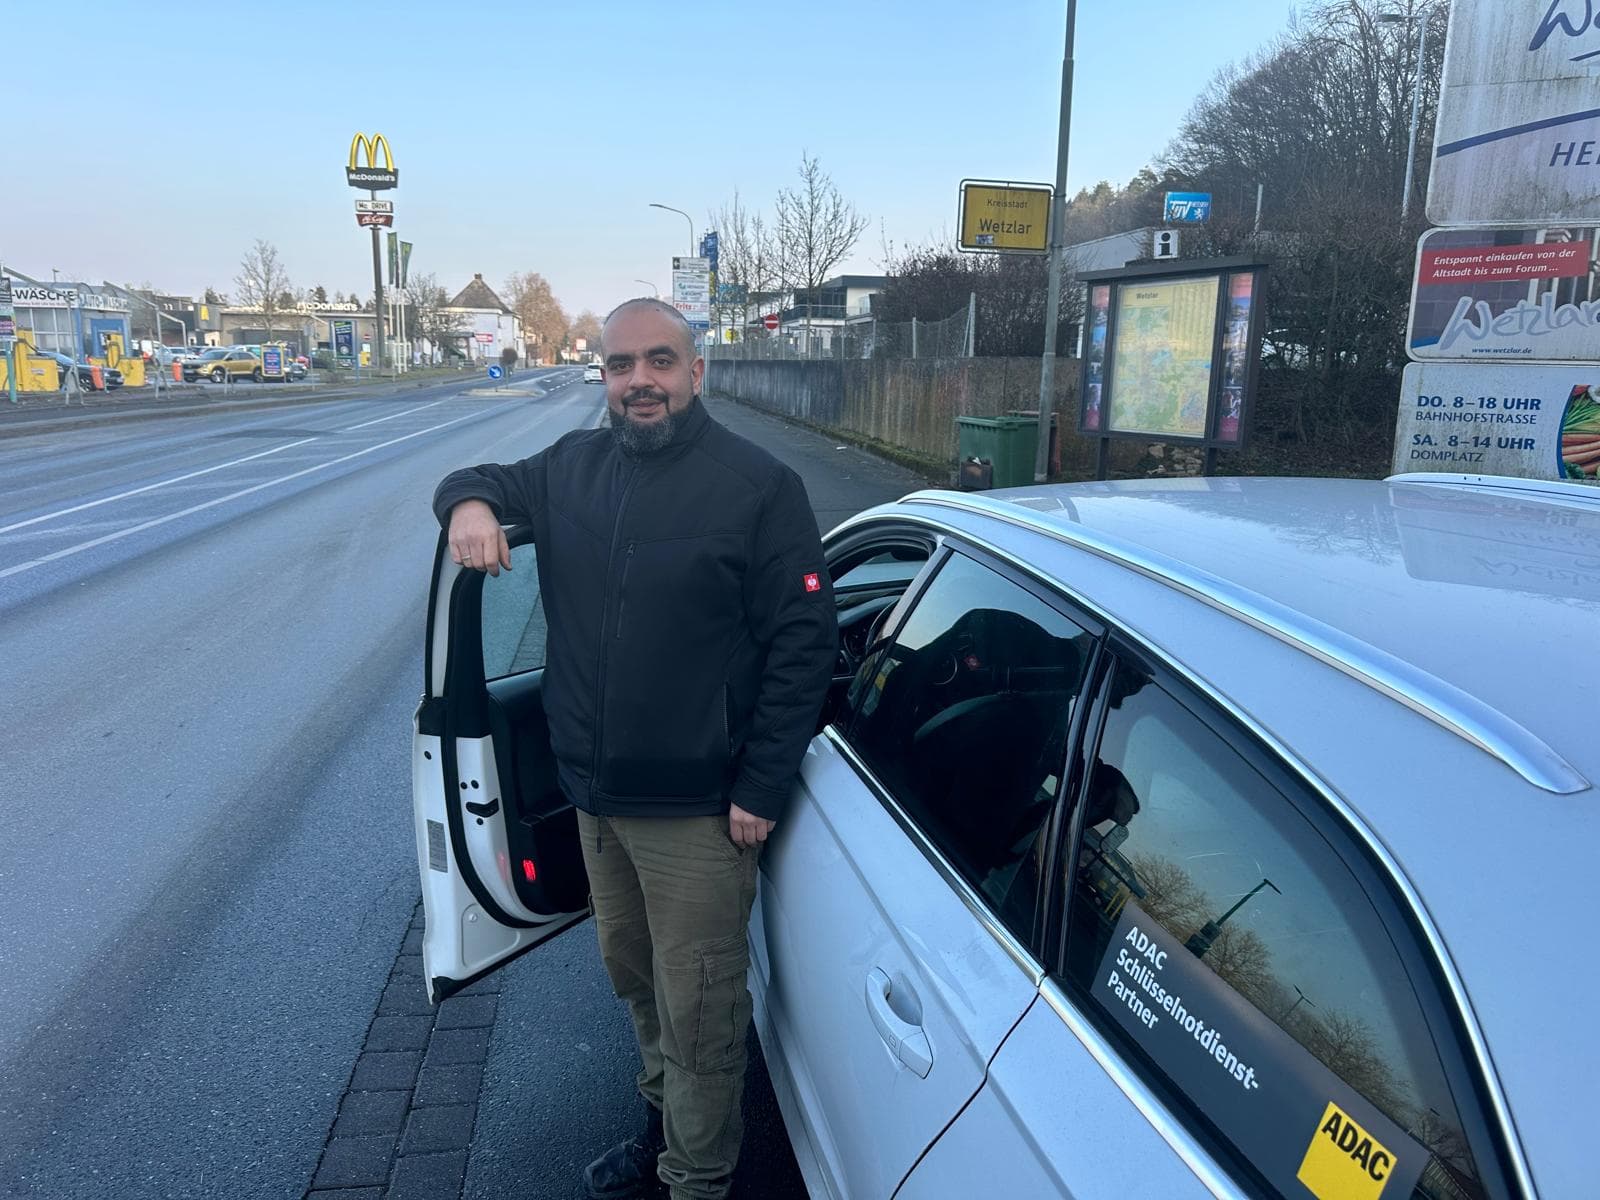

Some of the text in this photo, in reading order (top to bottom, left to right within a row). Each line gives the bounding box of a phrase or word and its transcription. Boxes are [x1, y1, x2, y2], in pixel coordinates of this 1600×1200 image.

[1549, 141, 1600, 167] HE
[349, 173, 396, 182] McDonald's
[987, 198, 1029, 208] Kreisstadt
[979, 217, 1033, 234] Wetzlar
[1434, 255, 1483, 266] Entspannt
[1485, 252, 1534, 263] einkaufen
[1558, 249, 1576, 258] der
[1432, 269, 1472, 278] Altstadt
[1474, 267, 1488, 276] bis
[1491, 267, 1512, 275] zum
[1515, 264, 1547, 273] Forum
[1136, 291, 1159, 300] Wetzlar
[1438, 291, 1600, 351] Wetzlar
[1472, 346, 1532, 354] www.wetzlar.de
[1417, 395, 1541, 411] DO. 8–18 UHR
[1415, 411, 1537, 425] BAHNHOFSTRASSE
[1412, 434, 1536, 450] SA. 8–14 UHR
[1410, 449, 1485, 463] DOMPLATZ
[1125, 926, 1168, 970] ADAC
[1107, 970, 1159, 1029] Partner
[1116, 948, 1259, 1090] Schlüsselnotdienst-
[1321, 1111, 1390, 1182] ADAC
